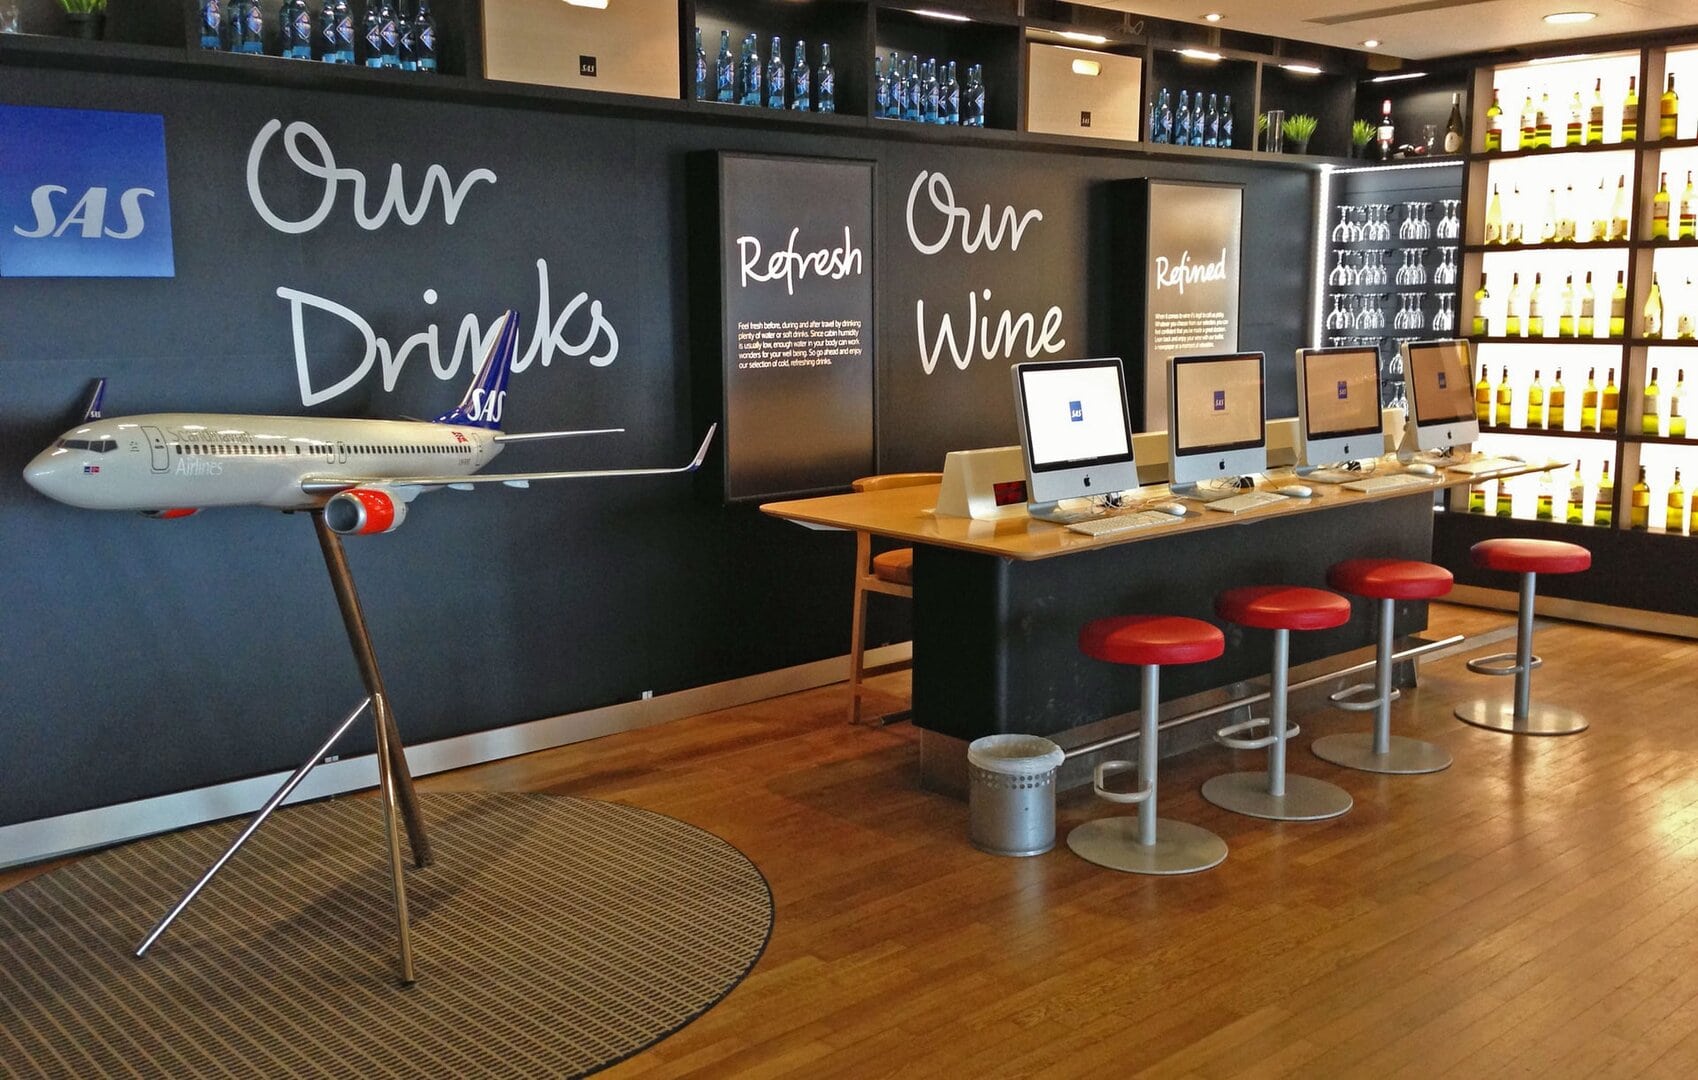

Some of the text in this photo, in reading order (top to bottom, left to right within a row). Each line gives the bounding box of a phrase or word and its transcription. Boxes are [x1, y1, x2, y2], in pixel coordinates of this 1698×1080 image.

[247, 119, 497, 233] Our
[14, 184, 154, 240] SAS
[907, 170, 1044, 254] Our
[737, 226, 863, 295] Refresh
[1155, 247, 1226, 295] Refined
[276, 258, 619, 406] Drinks
[916, 288, 1066, 375] Wine
[467, 388, 507, 422] SAS
[176, 457, 223, 476] Airlines
